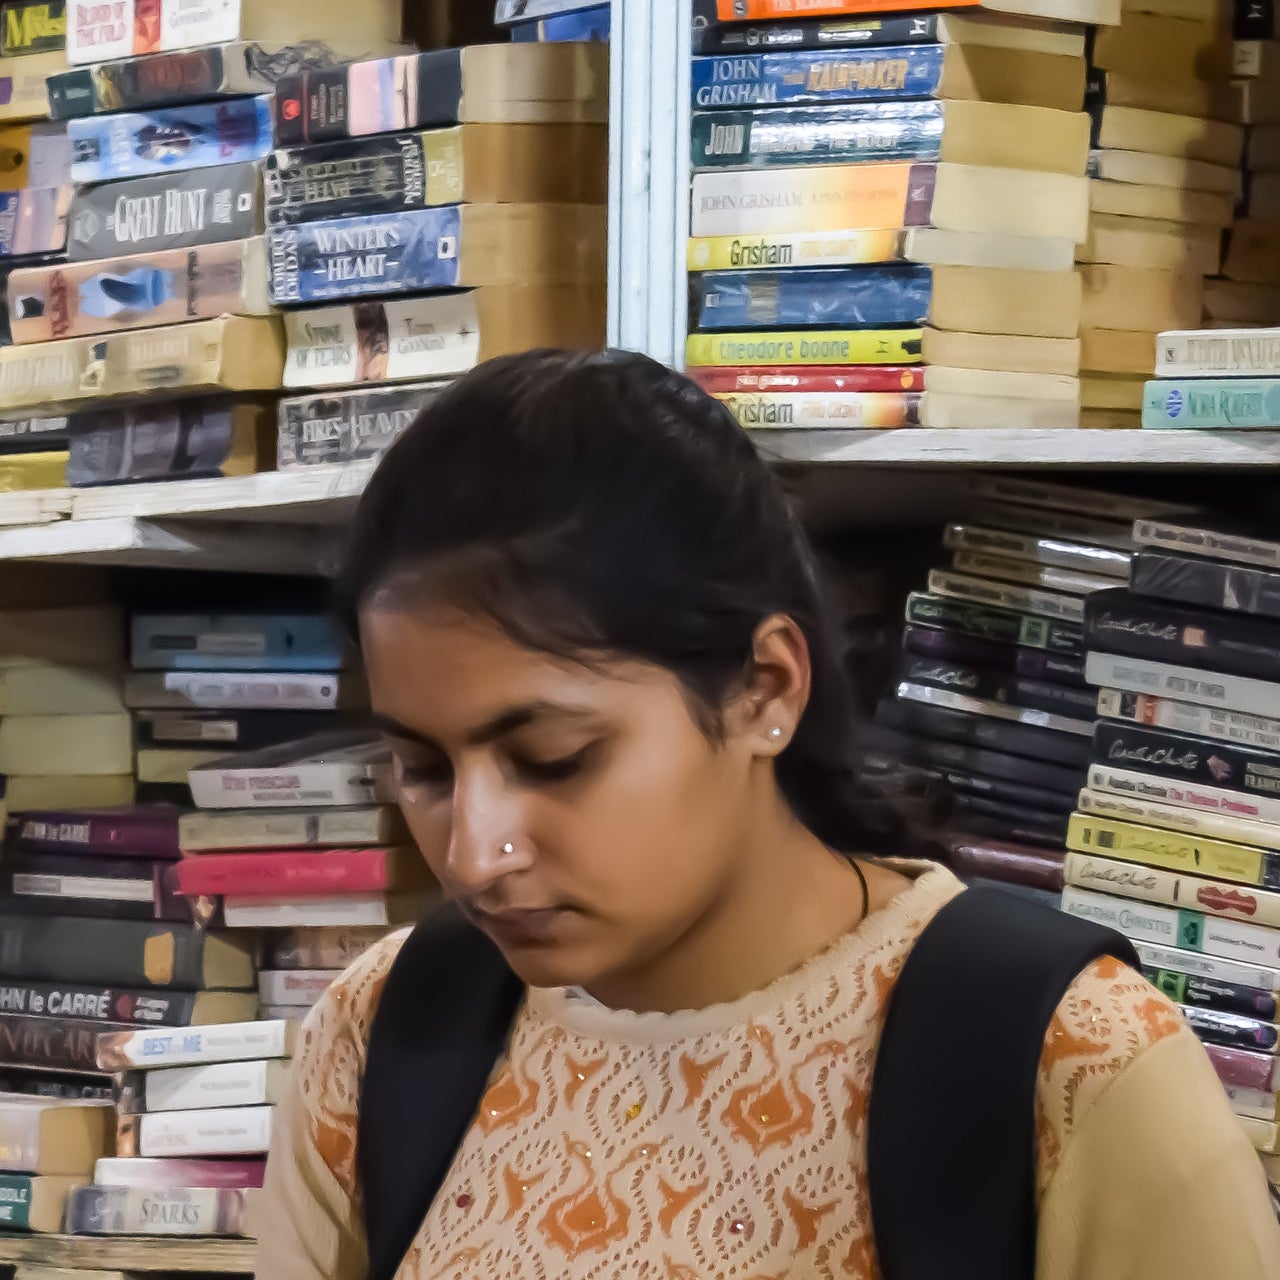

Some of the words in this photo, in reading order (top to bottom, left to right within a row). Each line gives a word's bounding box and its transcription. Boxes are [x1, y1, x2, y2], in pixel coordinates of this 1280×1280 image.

[713, 58, 761, 82] JOHN
[696, 83, 778, 106] GRISHAM
[730, 239, 792, 266] Grisham
[326, 253, 387, 282] HEART
[719, 340, 794, 361] theodore
[799, 339, 850, 359] boone
[1068, 902, 1118, 925] AGATHA
[1119, 909, 1173, 936] CHRISTIE
[29, 986, 44, 1014] le
[47, 986, 112, 1019] CARRÉ
[141, 1200, 201, 1226] SPARKS
